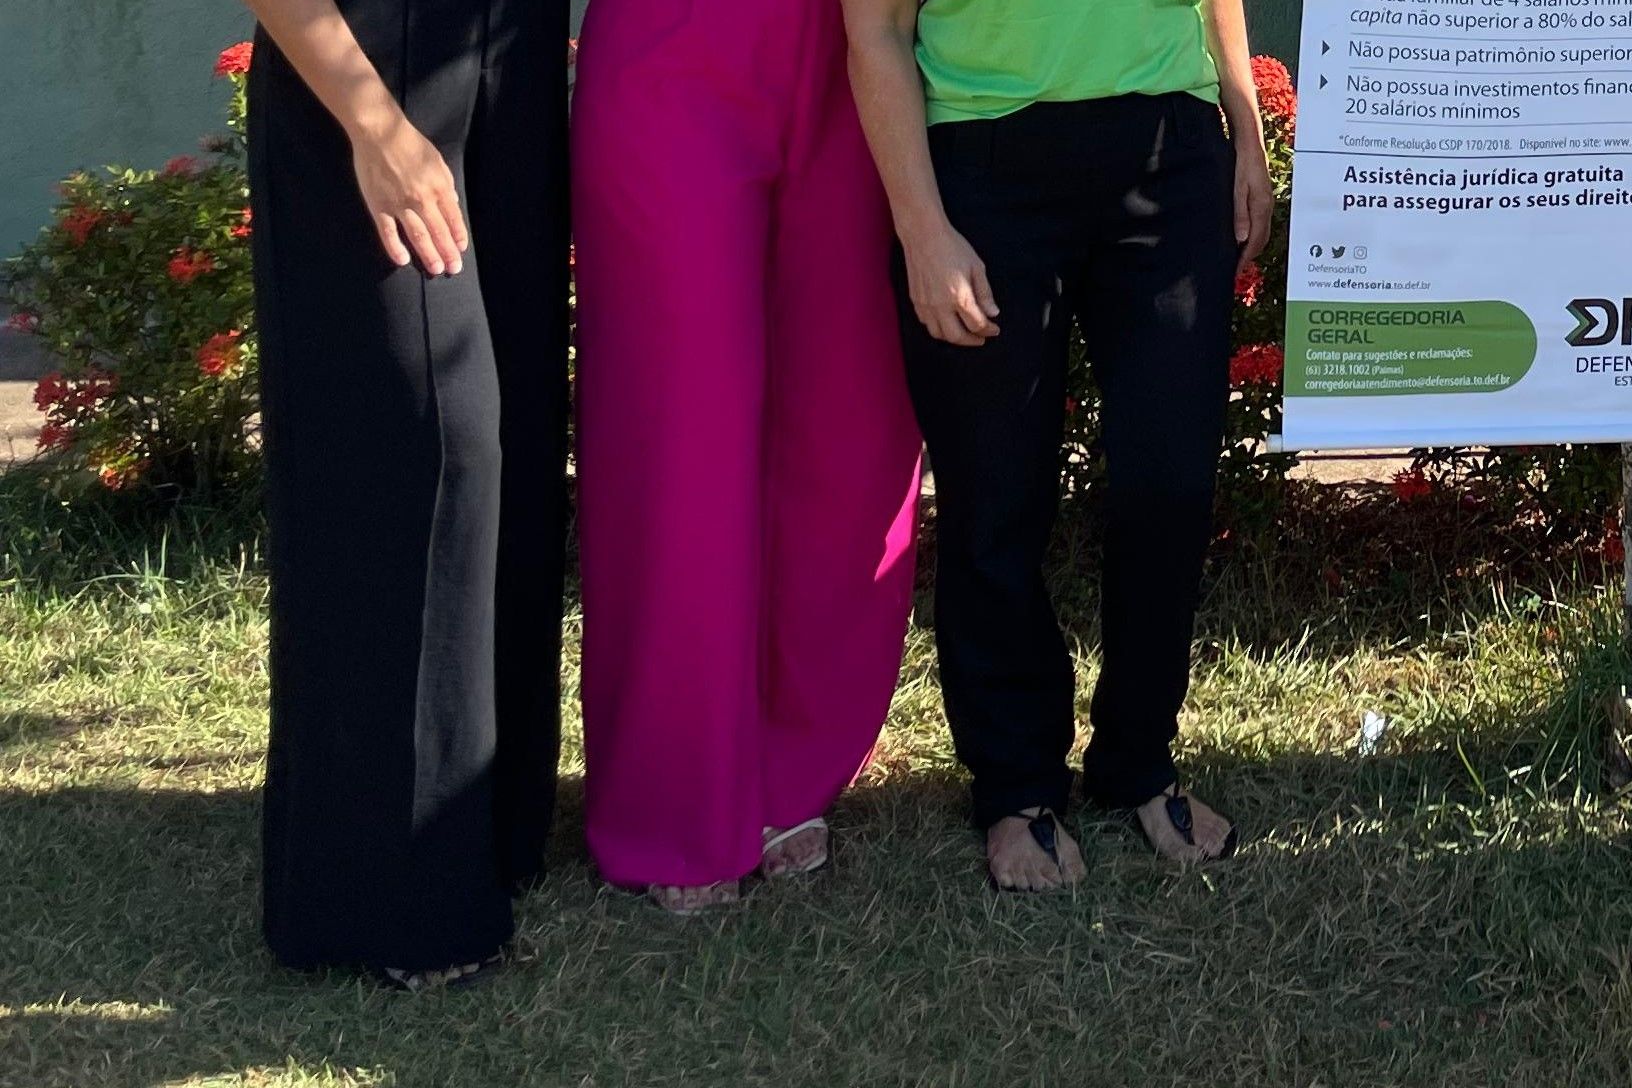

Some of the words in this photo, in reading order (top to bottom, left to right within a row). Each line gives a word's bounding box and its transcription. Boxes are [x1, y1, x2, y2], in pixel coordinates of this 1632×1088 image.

[1350, 9, 1402, 27] capita
[1407, 9, 1440, 27] não
[1445, 11, 1520, 31] superior
[1523, 16, 1534, 29] a
[1538, 11, 1577, 29] 80%
[1581, 11, 1605, 29] do
[1349, 40, 1384, 58] Não
[1388, 45, 1450, 64] possua
[1455, 47, 1556, 66] patrimônio
[1560, 45, 1632, 66] superior
[1347, 75, 1382, 93] Não
[1387, 80, 1449, 98] possua
[1454, 80, 1580, 98] investimentos
[1345, 98, 1367, 114] 20
[1371, 100, 1437, 118] salários
[1442, 103, 1520, 119] mínimos
[1390, 138, 1437, 152] Resolução
[1439, 139, 1463, 151] CSDP
[1466, 139, 1512, 151] 170/2018.
[1569, 140, 1580, 149] no
[1583, 137, 1602, 149] site:
[1344, 166, 1456, 186] Assistência
[1460, 167, 1538, 190] jurídica
[1544, 165, 1624, 188] gratuita
[1343, 193, 1388, 211] para
[1393, 195, 1494, 214] assegurar
[1499, 195, 1521, 209] os
[1527, 192, 1570, 207] seus
[1307, 264, 1367, 275] DefensoriaTO
[1307, 278, 1431, 291] www.defensoria.to.def.br
[1308, 309, 1466, 326] CORREGEDORIA
[1308, 329, 1375, 344] GERAL
[1305, 348, 1341, 361] Contato
[1342, 350, 1363, 363] para
[1364, 349, 1408, 363] sugestões
[1409, 351, 1416, 360] e
